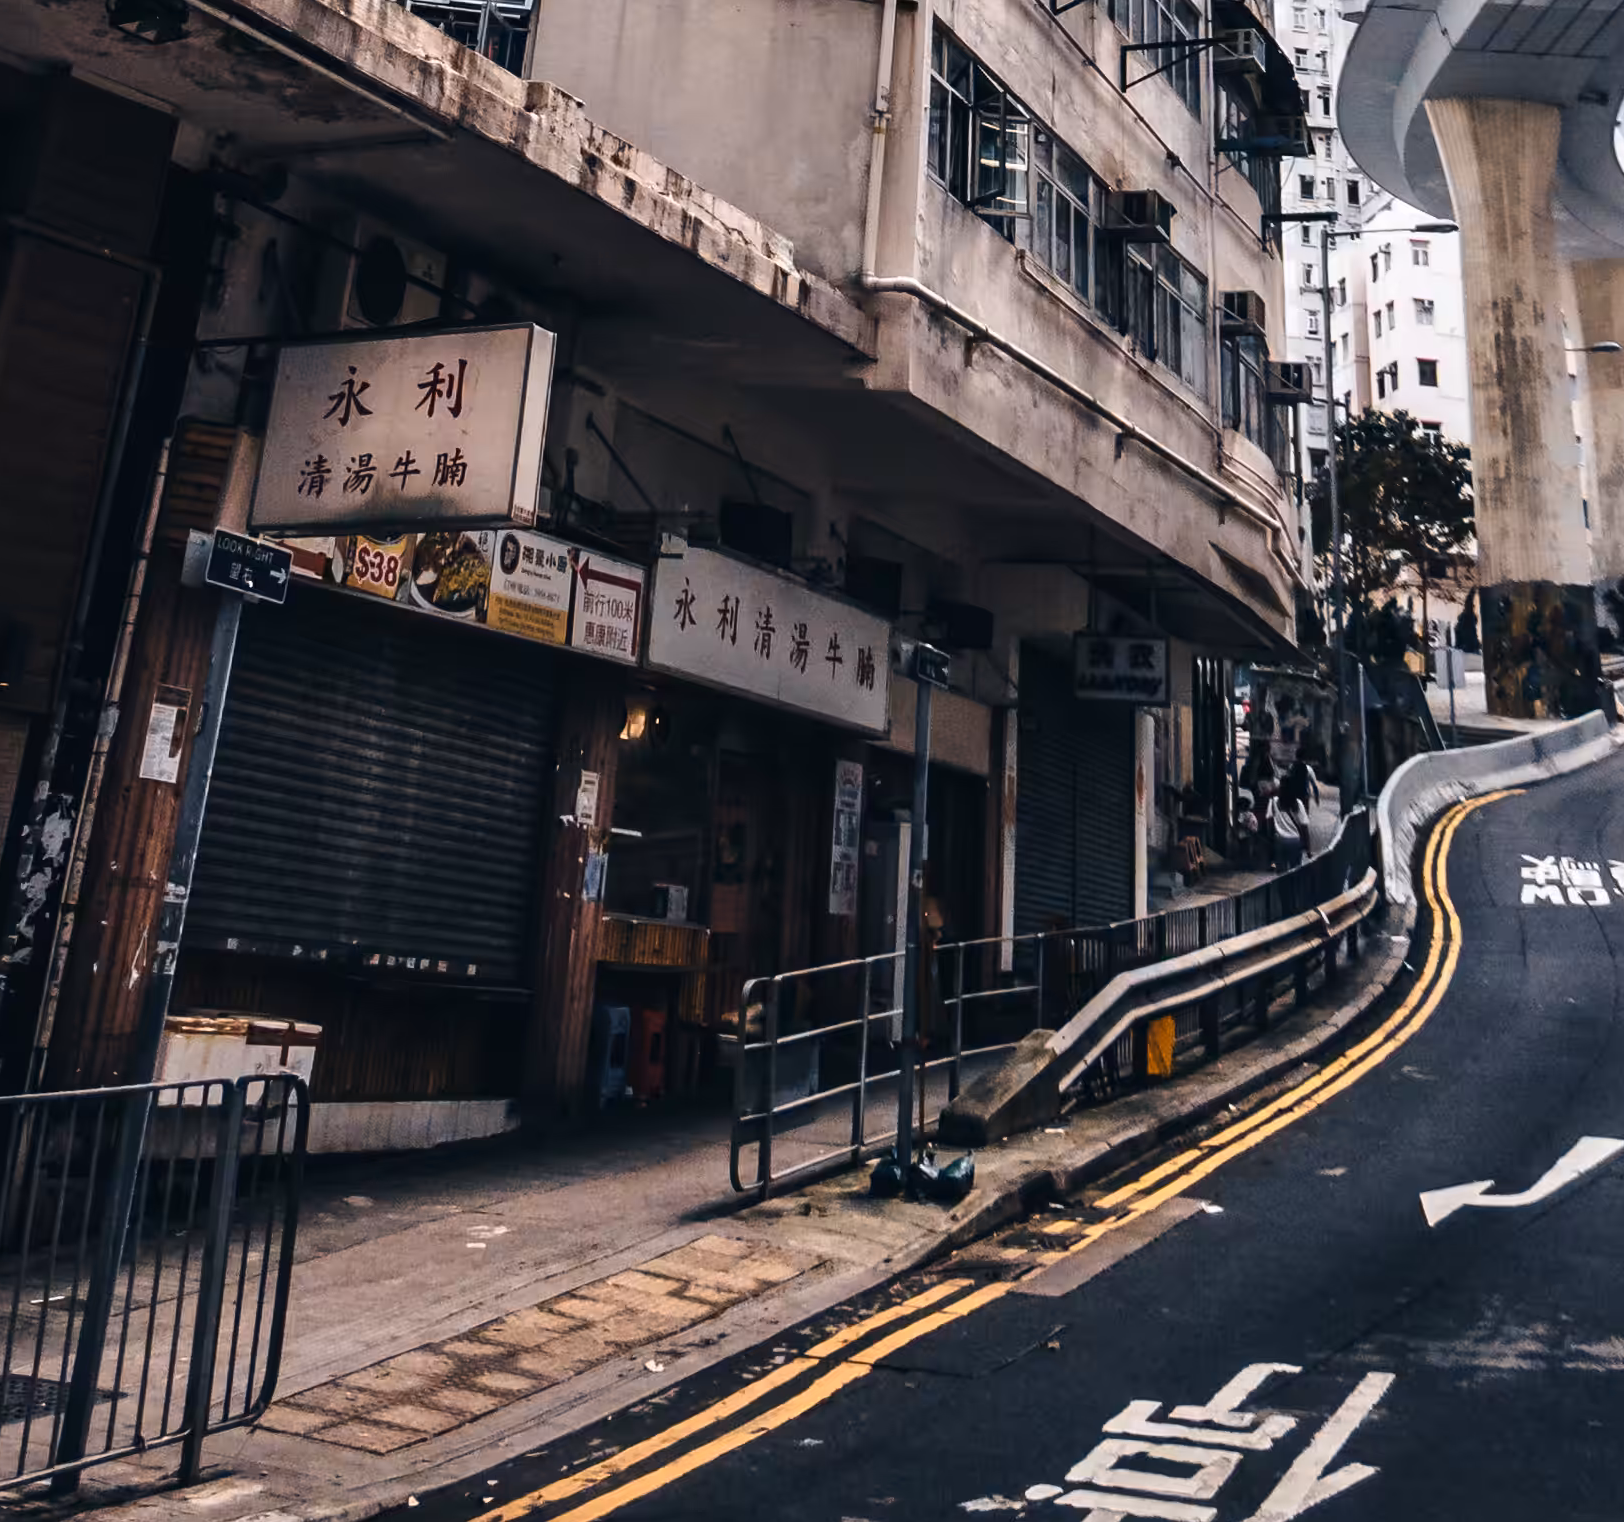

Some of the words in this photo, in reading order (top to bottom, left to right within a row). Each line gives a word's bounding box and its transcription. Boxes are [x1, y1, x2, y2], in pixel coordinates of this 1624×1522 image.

[322, 358, 468, 427] 永利
[298, 448, 468, 499] 清湯牛腩
[217, 537, 244, 553] LOOK
[245, 545, 274, 565] RGHT
[355, 545, 399, 587] $38
[583, 591, 634, 623] 前行100米
[673, 577, 876, 691] 永利清湯牛腩
